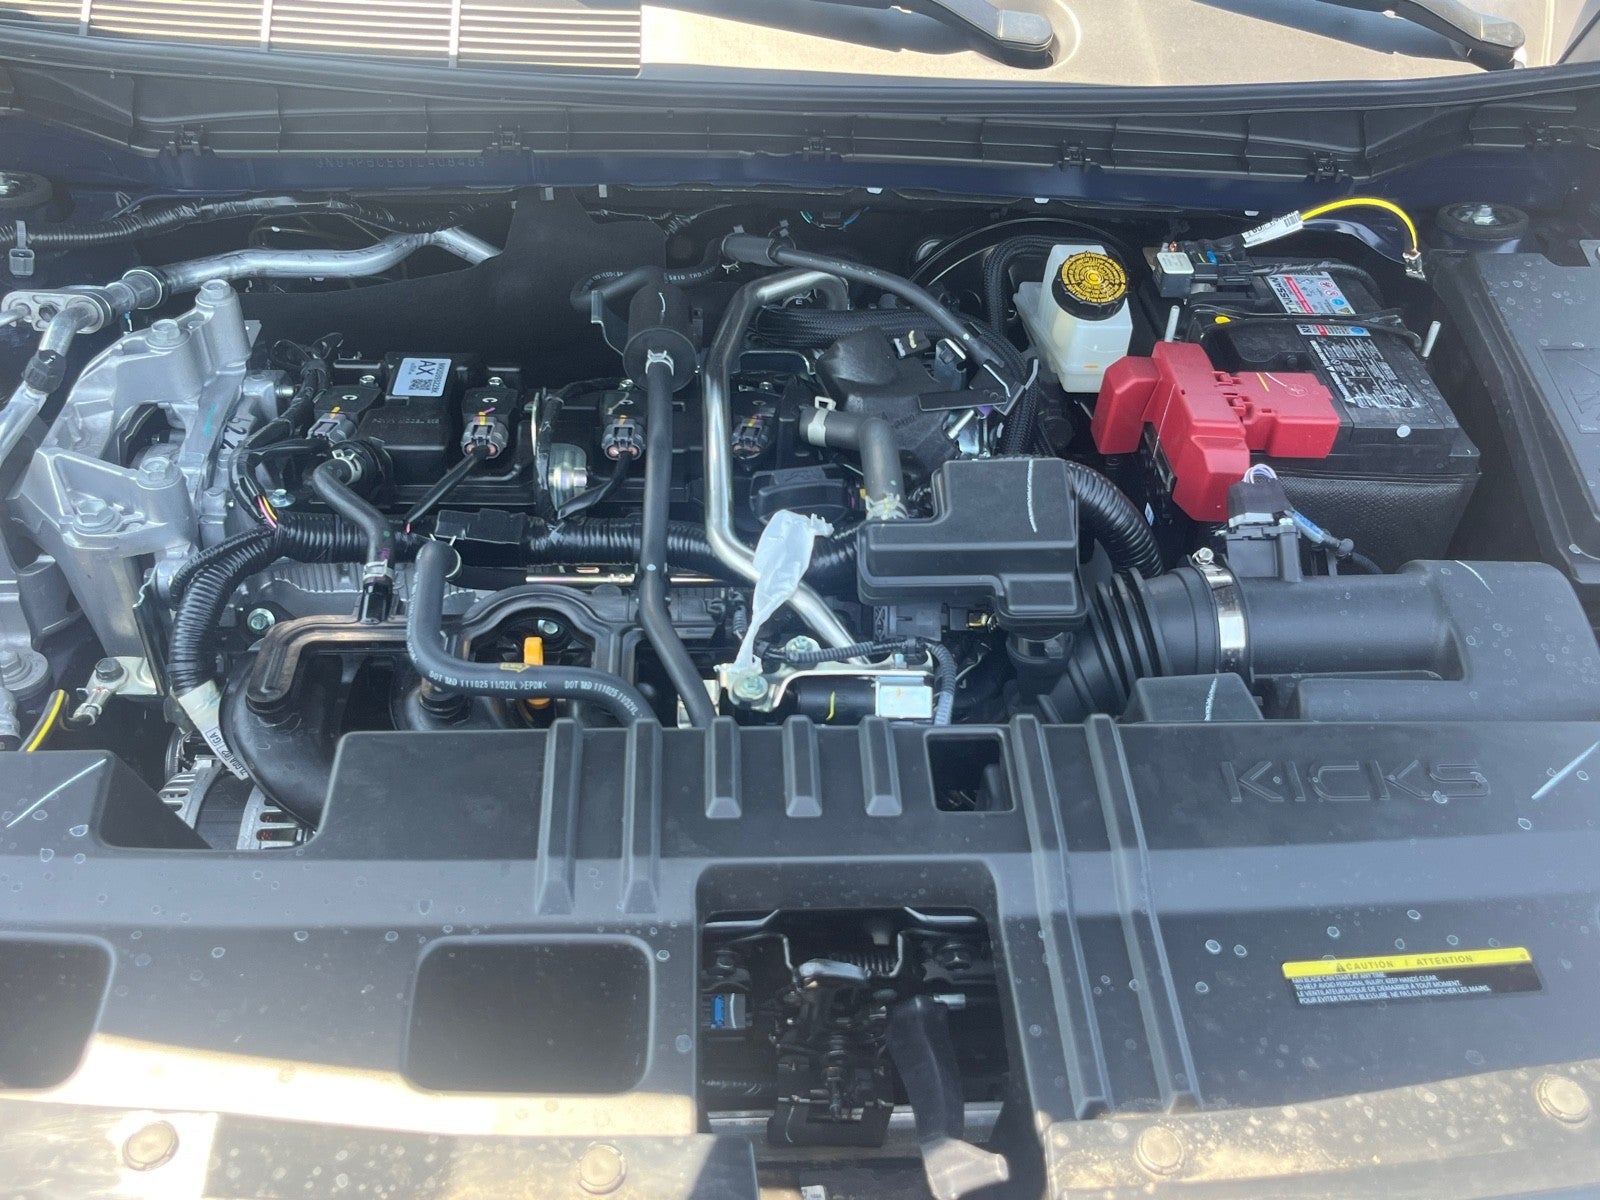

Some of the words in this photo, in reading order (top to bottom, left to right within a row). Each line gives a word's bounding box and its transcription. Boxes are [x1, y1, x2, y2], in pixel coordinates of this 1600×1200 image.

[1221, 760, 1491, 802] KICKS
[1346, 960, 1394, 971] CAUTION
[1416, 955, 1473, 966] ATTENTION
